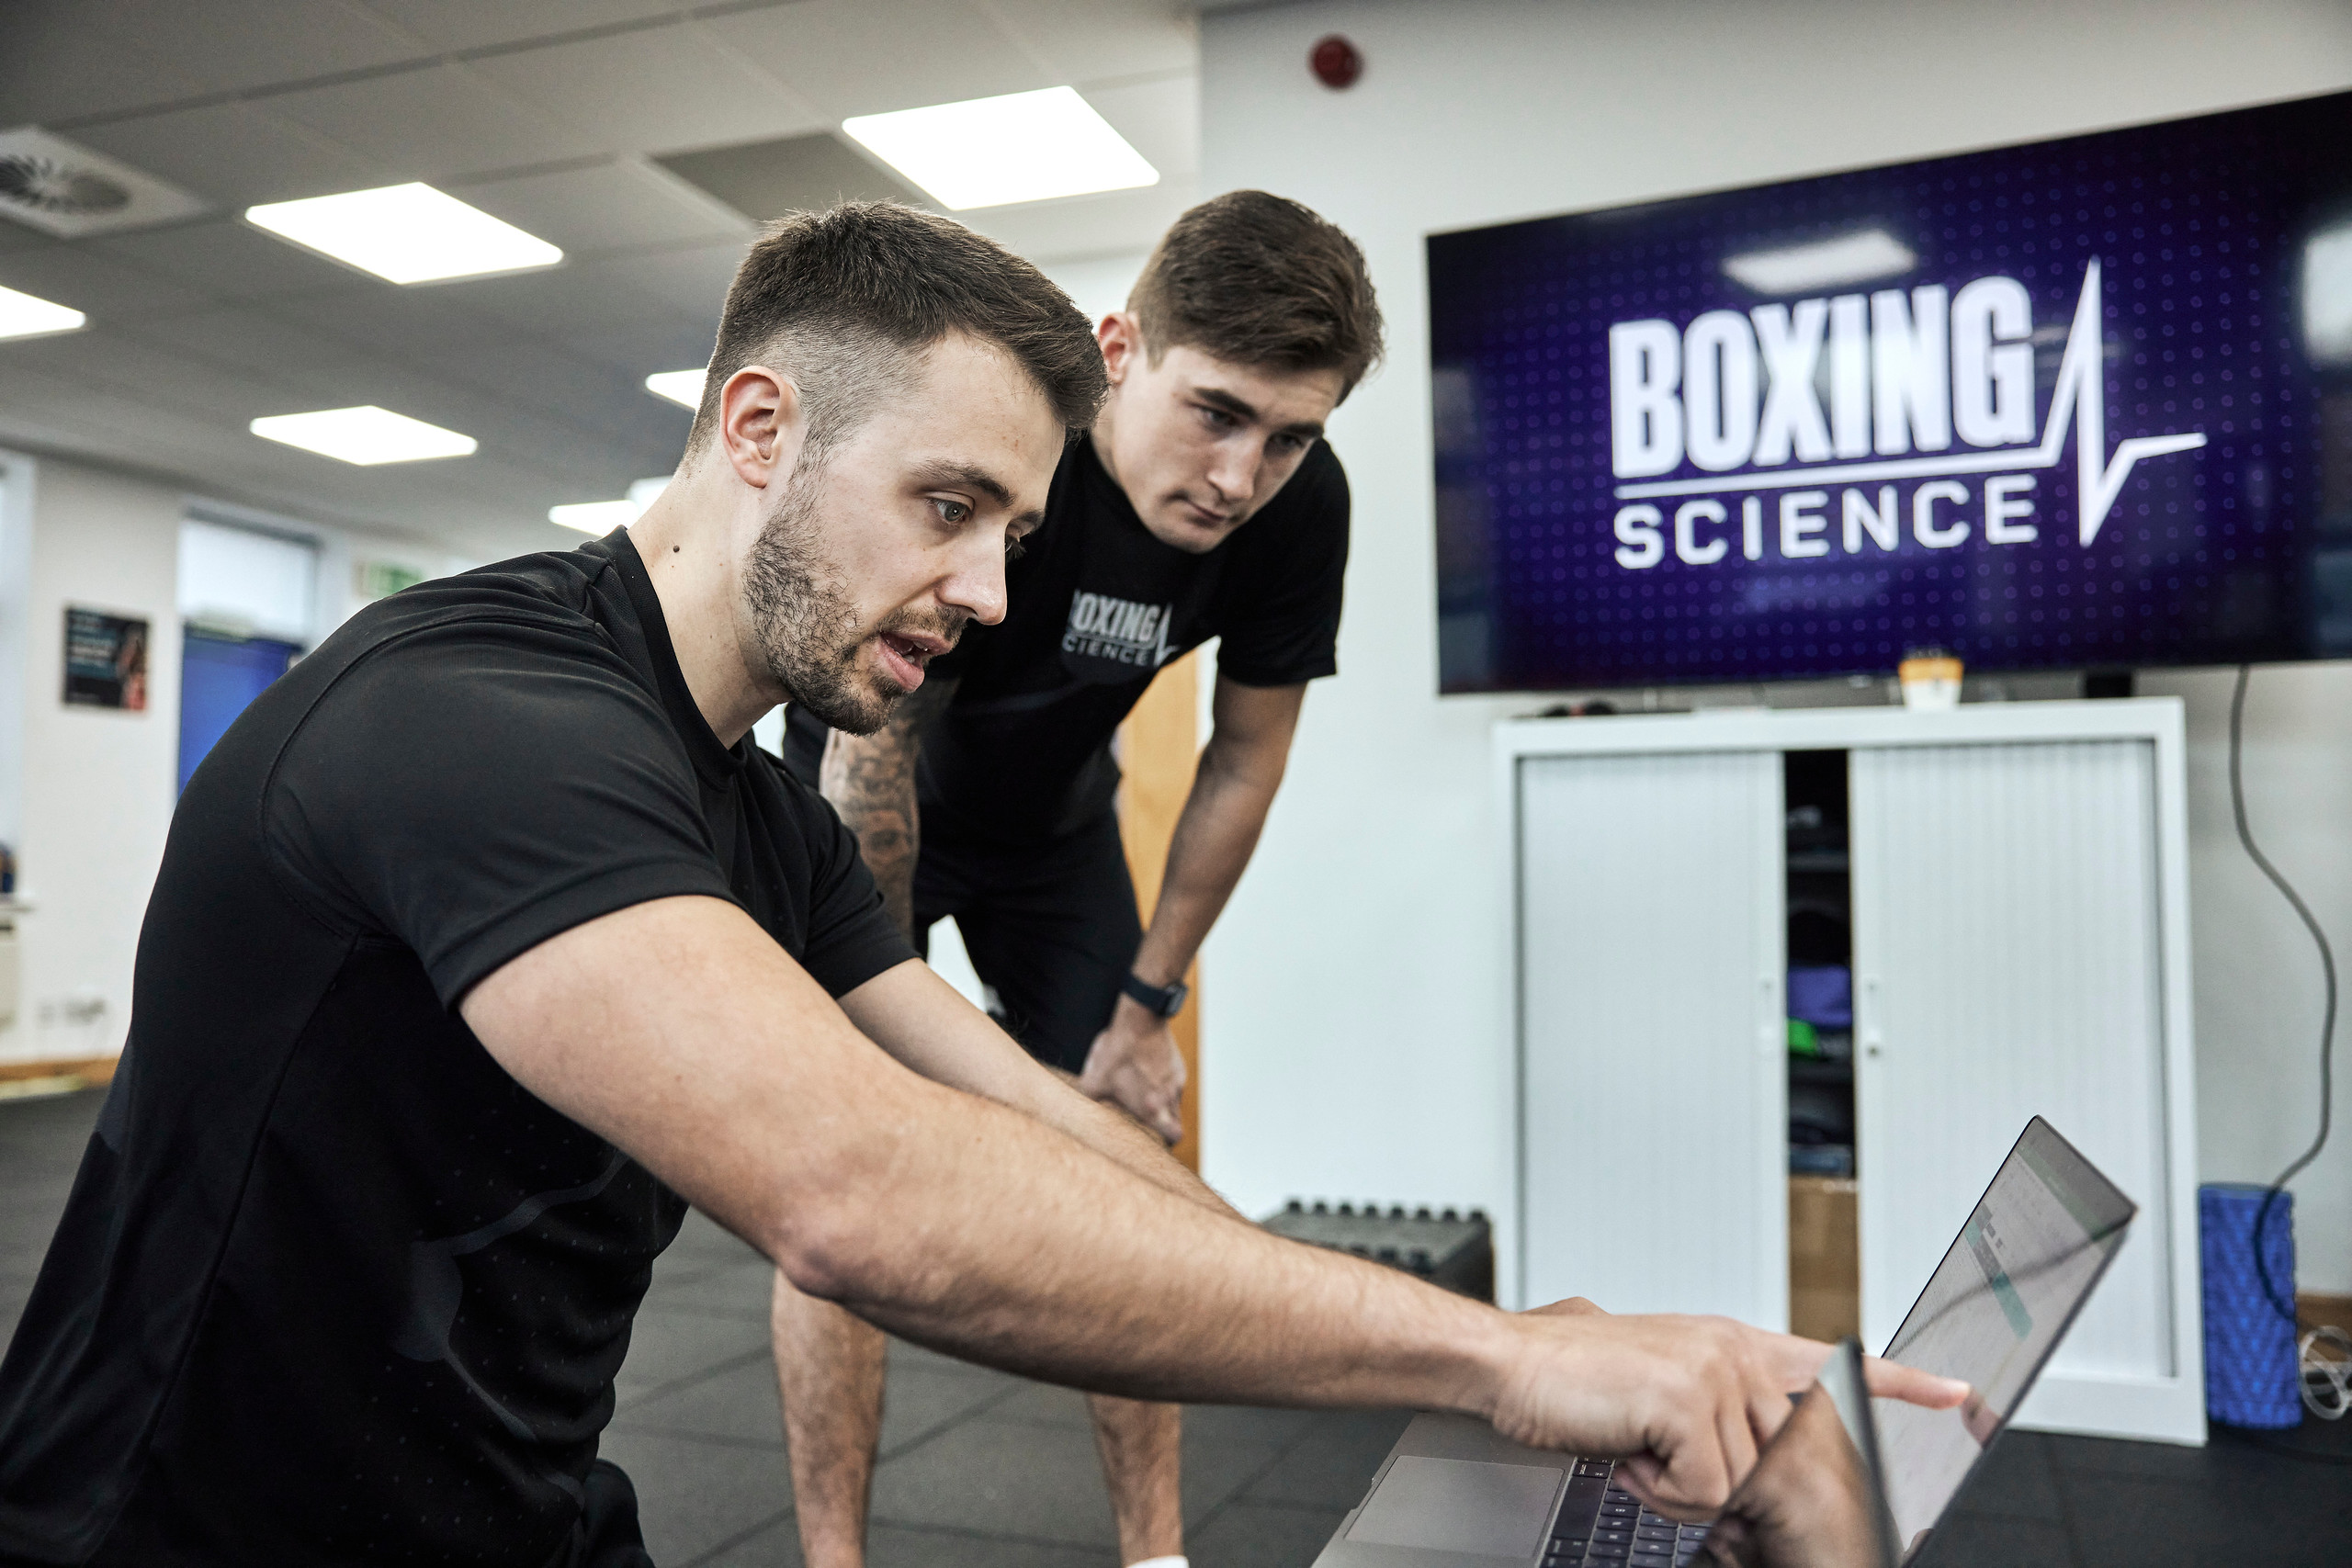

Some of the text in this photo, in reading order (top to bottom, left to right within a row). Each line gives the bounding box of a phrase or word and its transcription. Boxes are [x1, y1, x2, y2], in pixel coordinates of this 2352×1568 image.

[1610, 275, 2036, 479] BOXING
[1613, 474, 2039, 570] SCIENCE
[1062, 633, 1148, 666] CIENCE
